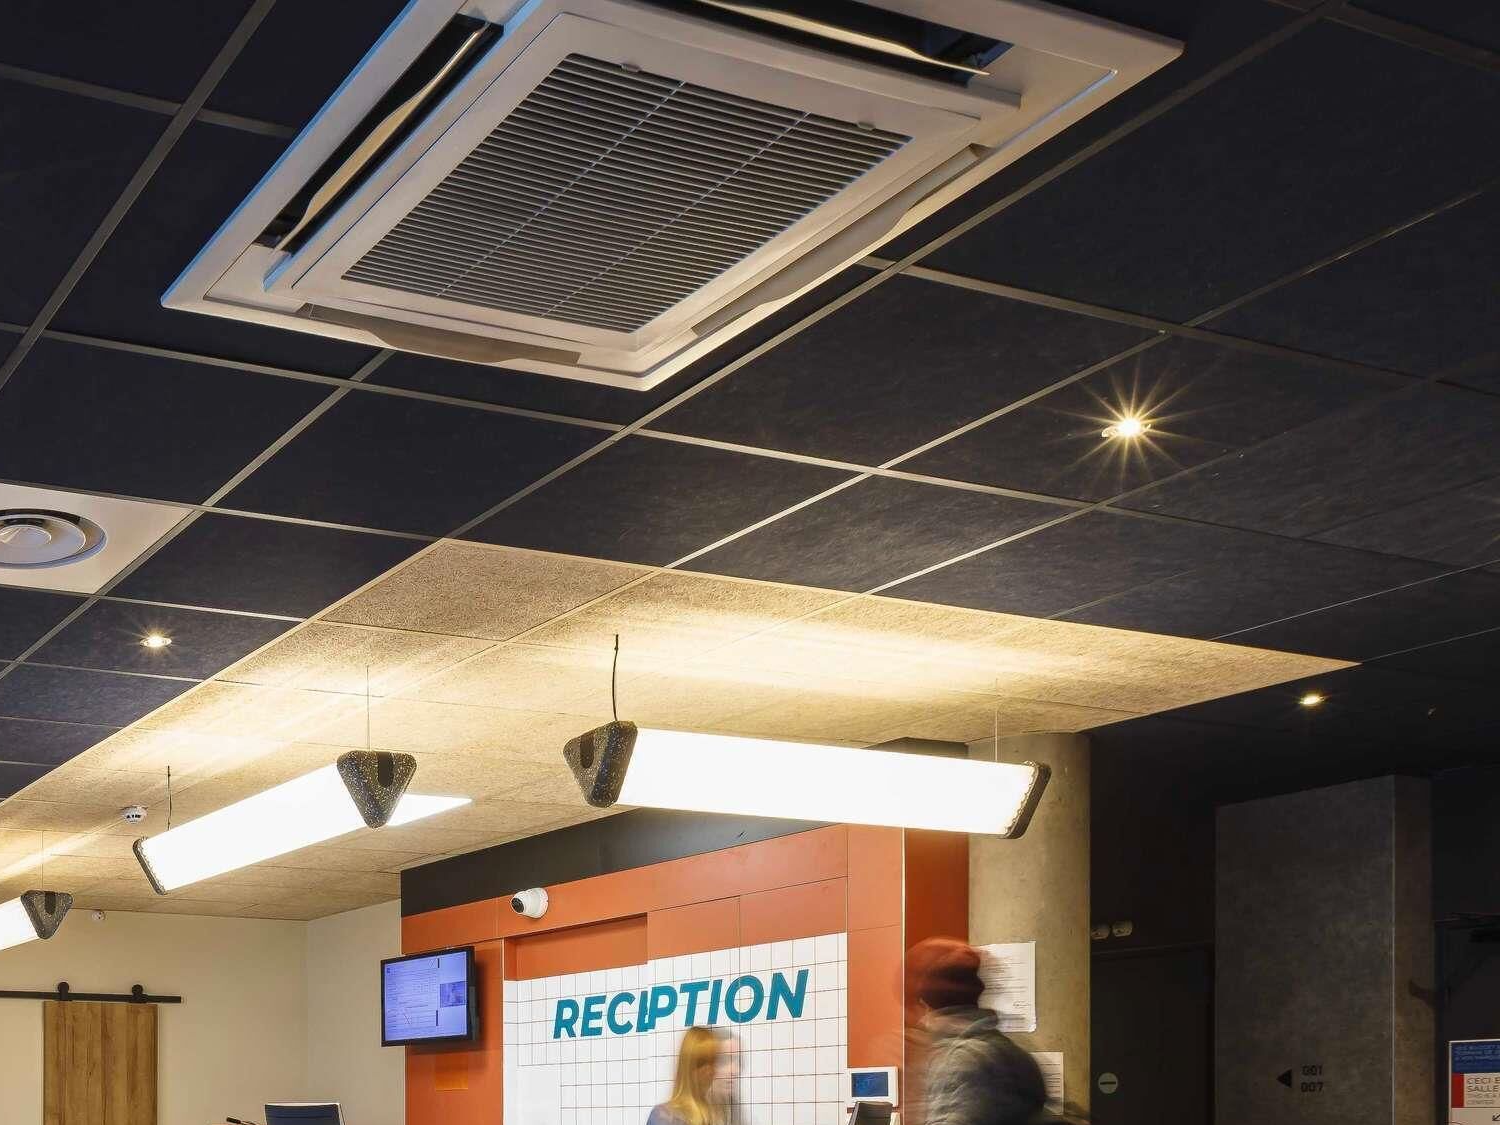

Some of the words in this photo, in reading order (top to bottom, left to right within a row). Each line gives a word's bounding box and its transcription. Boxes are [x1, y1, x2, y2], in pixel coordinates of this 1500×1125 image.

[1302, 1064, 1323, 1076] 001
[1301, 1081, 1324, 1093] 007
[1467, 1085, 1499, 1093] SALLE
